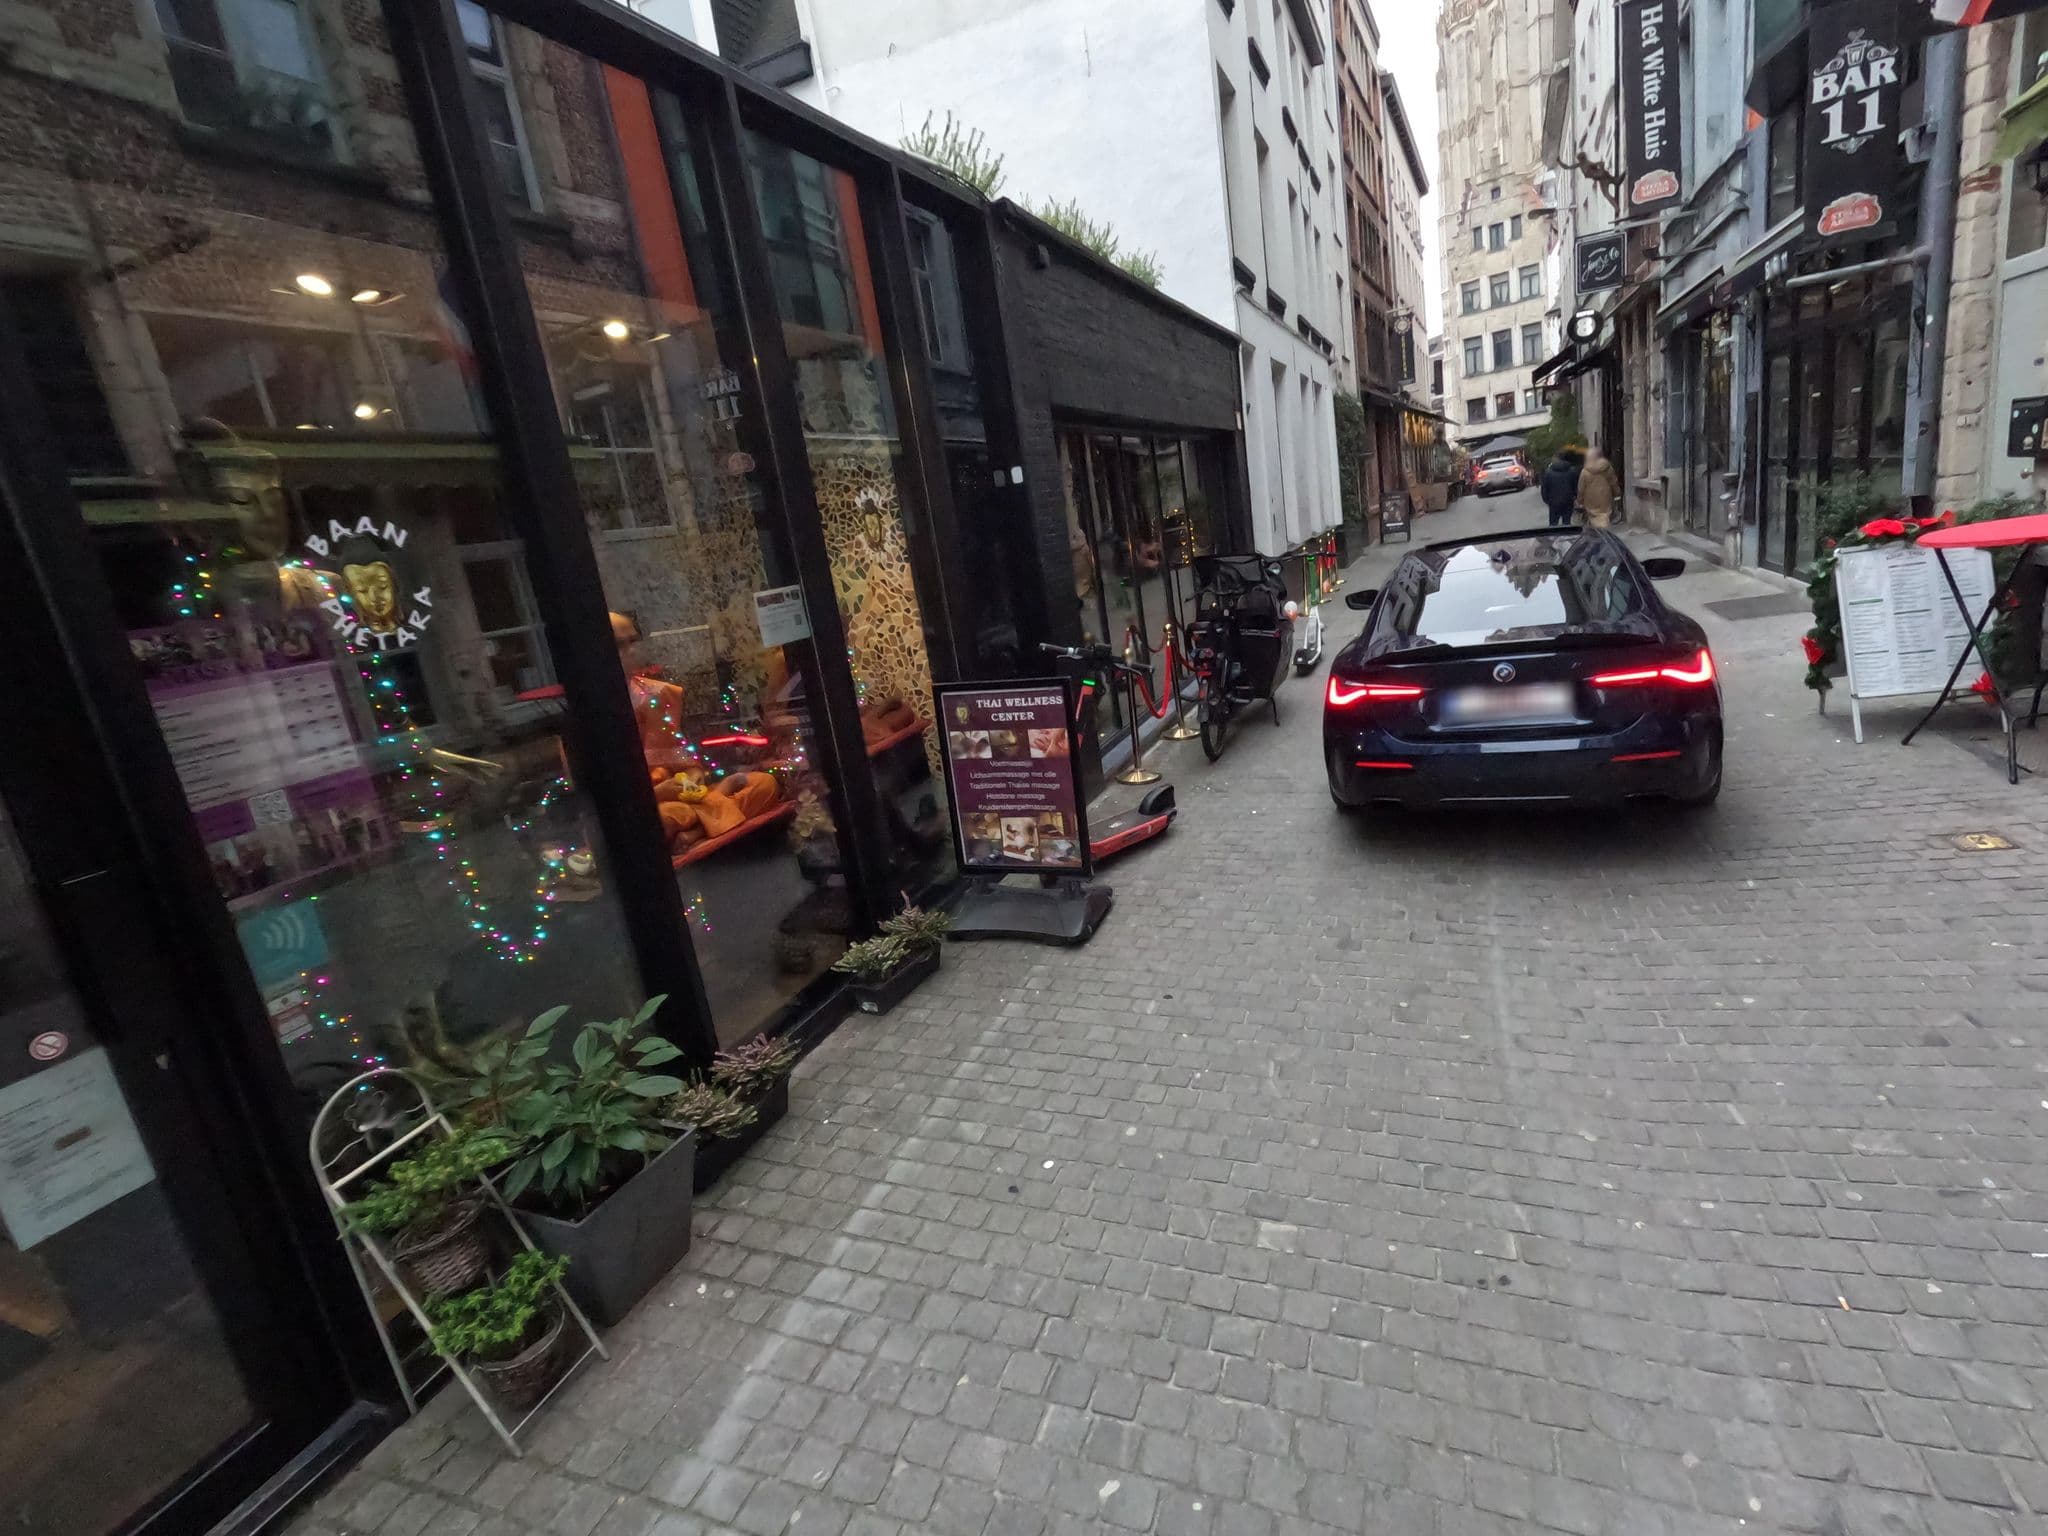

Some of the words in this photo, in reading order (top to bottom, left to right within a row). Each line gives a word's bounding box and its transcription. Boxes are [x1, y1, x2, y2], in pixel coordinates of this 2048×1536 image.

[1641, 3, 1663, 47] Het
[1642, 46, 1665, 107] Witte
[1812, 57, 1898, 104] BAR
[1644, 107, 1667, 160] Huis
[1820, 90, 1886, 145] 11
[304, 516, 408, 556] BAAN
[976, 699, 1002, 708] THAI
[1004, 696, 1064, 707] WELLNESS
[991, 712, 1035, 721] CENTER
